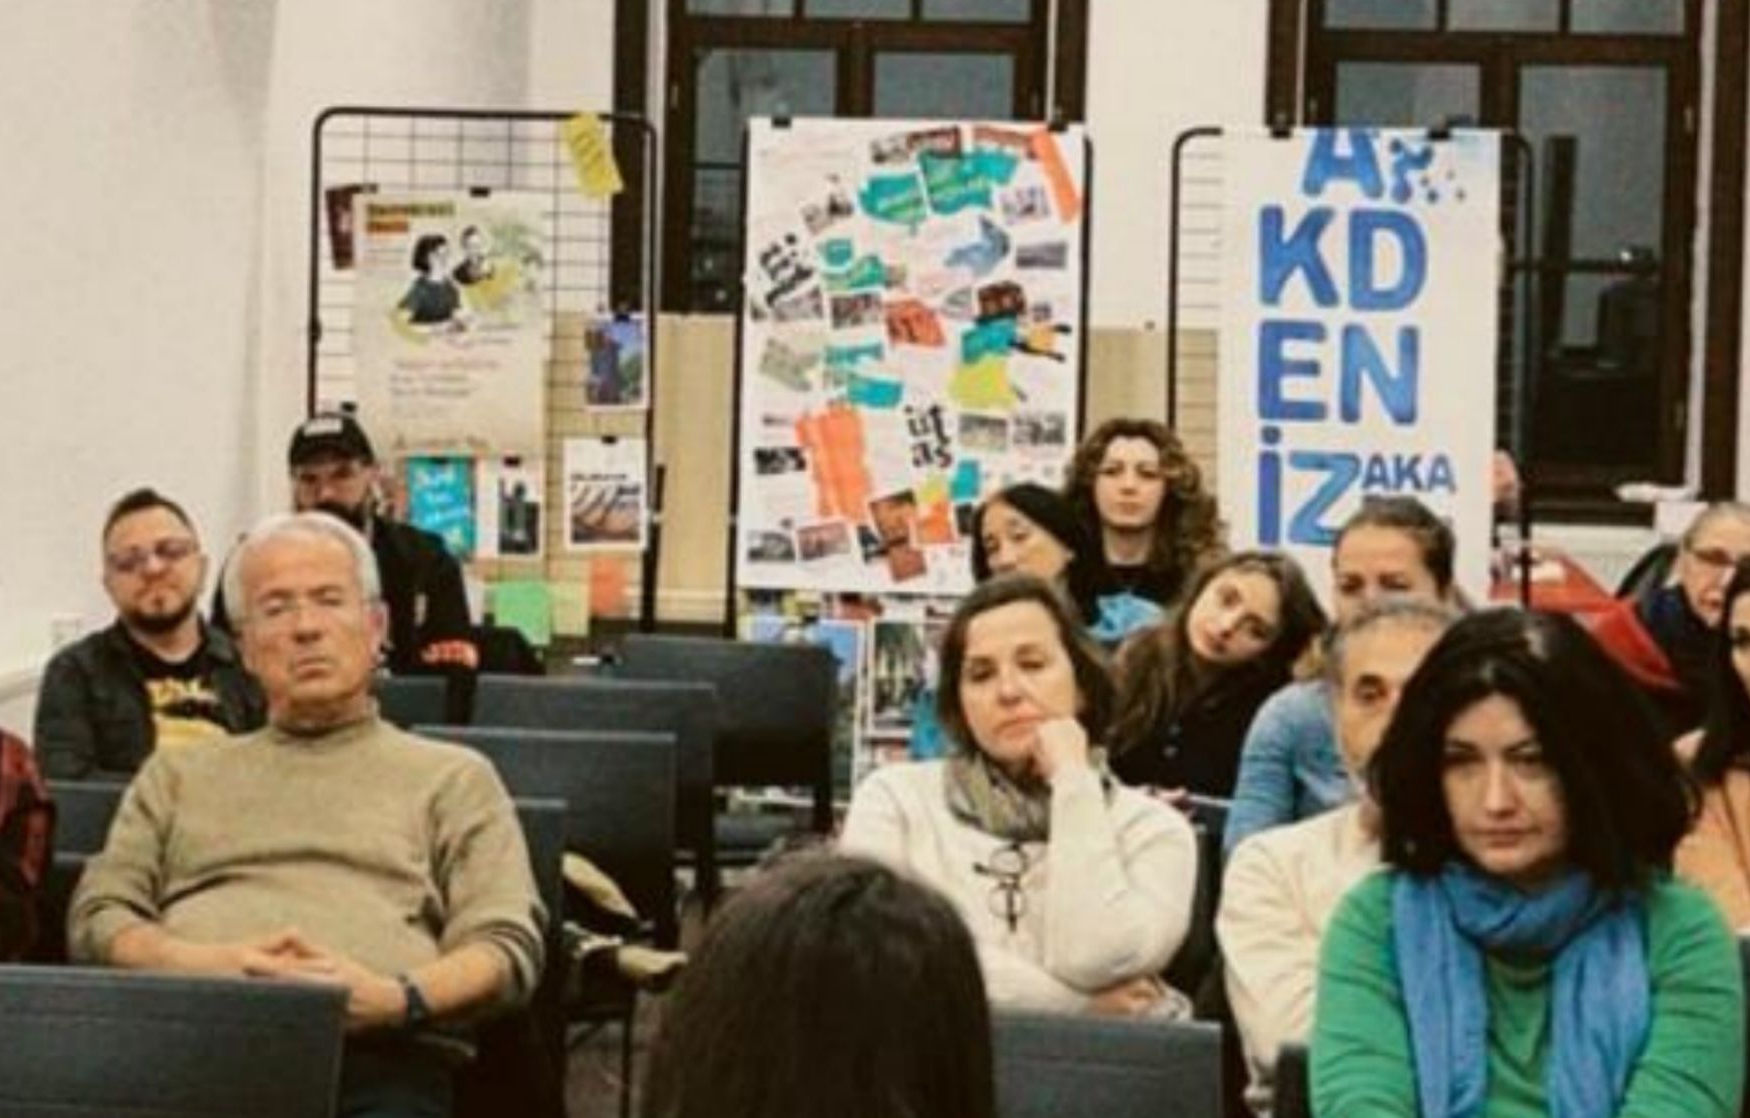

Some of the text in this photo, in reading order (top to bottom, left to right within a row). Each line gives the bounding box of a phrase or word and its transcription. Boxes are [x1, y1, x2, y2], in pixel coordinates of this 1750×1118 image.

[1258, 206, 1428, 311] KD
[1257, 320, 1421, 426] EN
[1363, 454, 1456, 492] AKA
